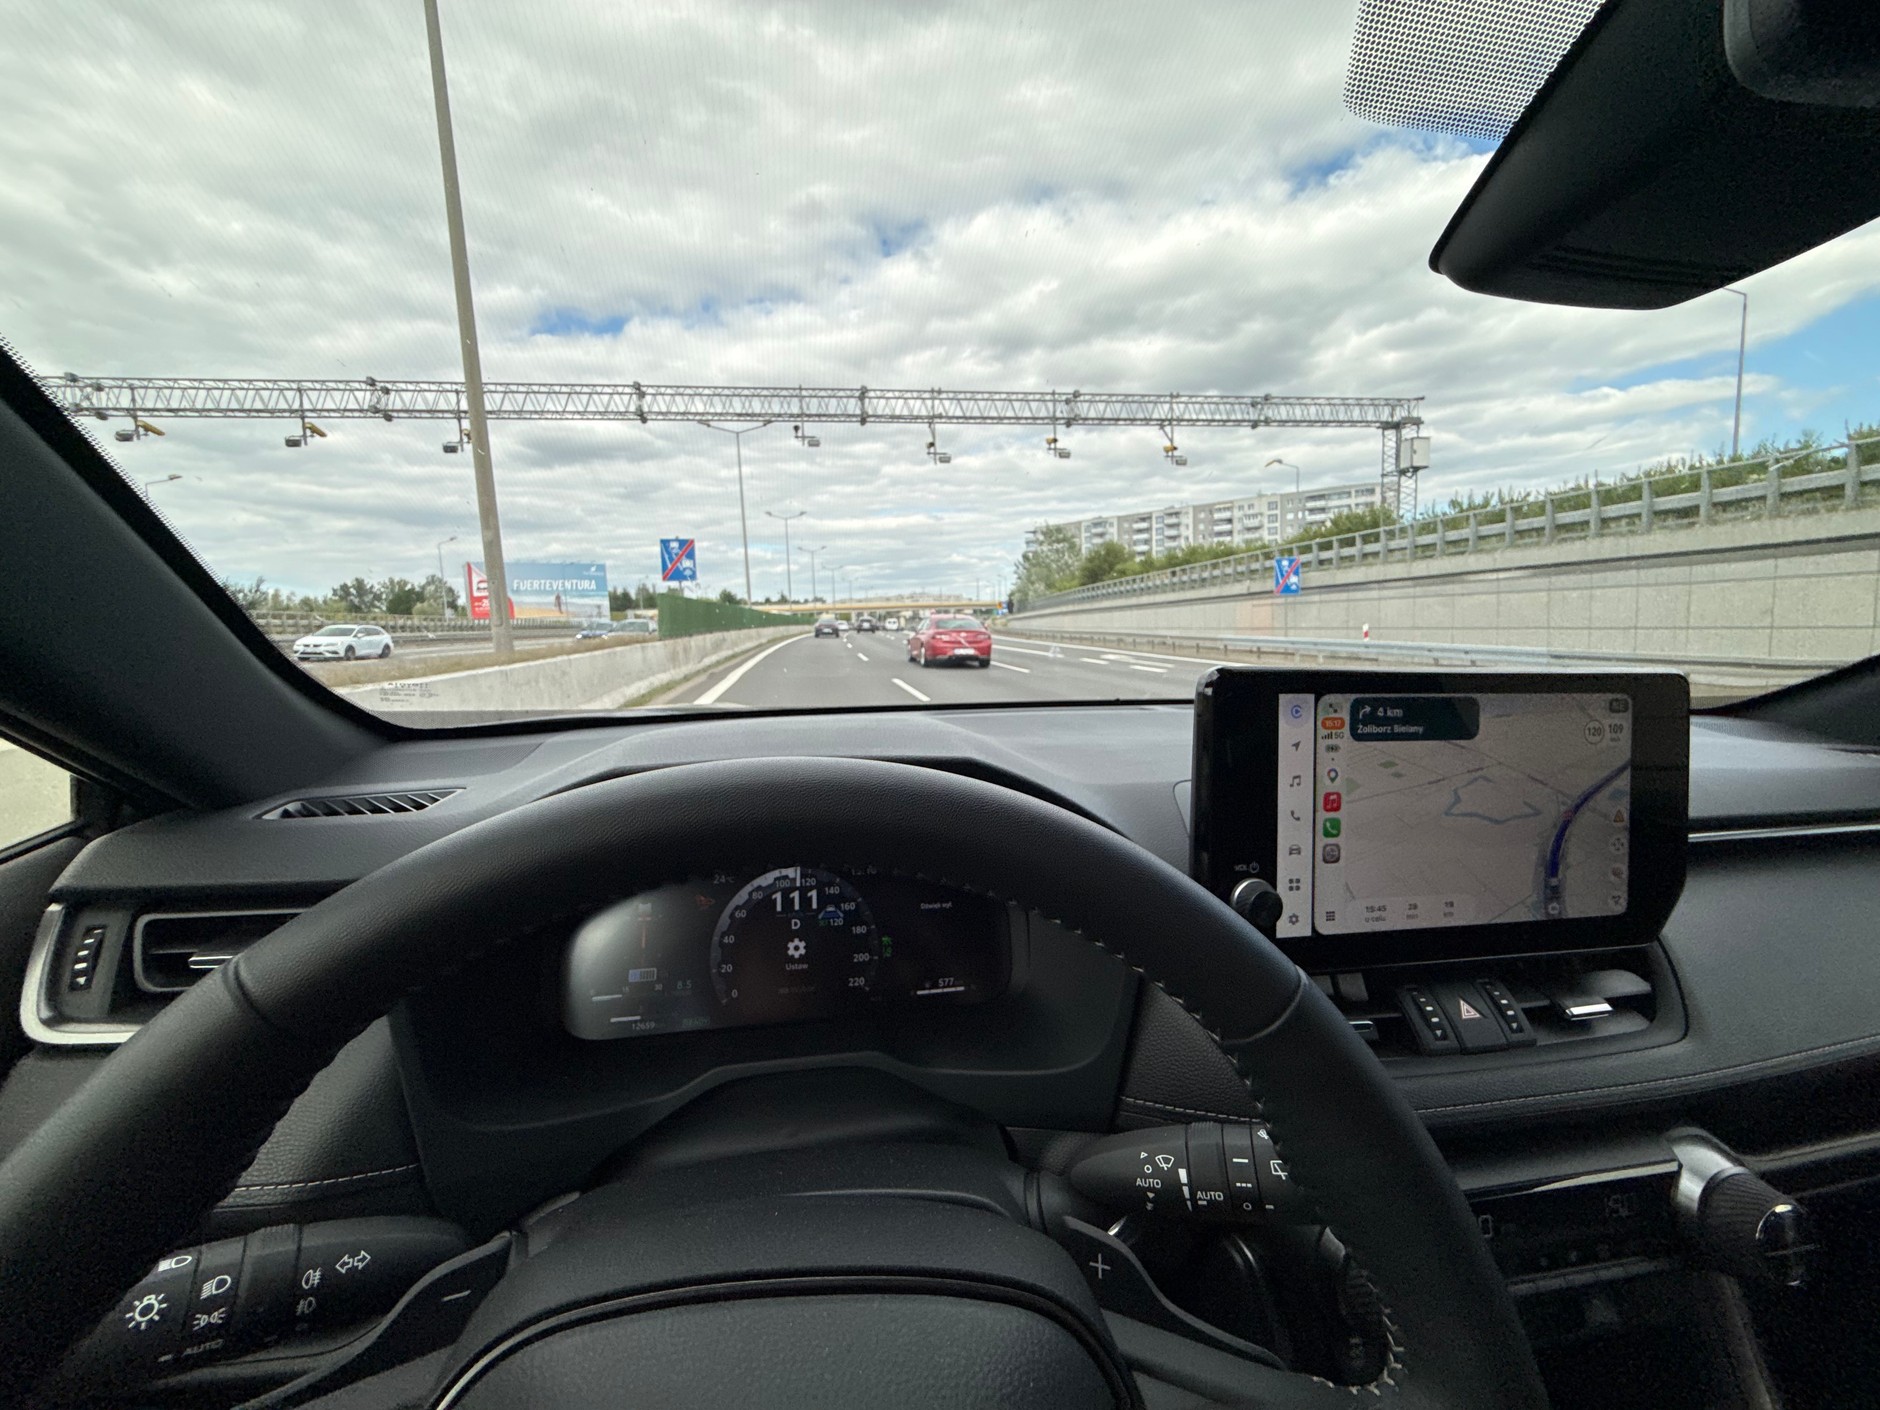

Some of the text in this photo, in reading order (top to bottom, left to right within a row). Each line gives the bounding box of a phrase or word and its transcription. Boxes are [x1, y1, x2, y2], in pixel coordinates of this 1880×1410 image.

[513, 579, 597, 591] FUERTEVENTURA
[1377, 707, 1404, 717] 4 km
[1357, 724, 1424, 735] Żoliborz Bielany
[1587, 726, 1602, 737] 120
[1608, 723, 1624, 735] 109
[1334, 731, 1345, 740] 5G
[775, 880, 791, 888] 100
[801, 878, 817, 887] 120
[752, 891, 763, 900] 80
[824, 886, 840, 895] 140
[772, 889, 818, 912] 111
[840, 902, 856, 911] 160
[735, 909, 747, 919] 60
[791, 918, 801, 930] D
[829, 918, 844, 926] 120
[851, 925, 867, 934] 180
[722, 935, 735, 944] 40
[853, 953, 870, 962] 200
[720, 963, 732, 973] 20
[785, 961, 809, 971] Ustaw
[848, 977, 865, 987] 220
[938, 977, 954, 987] 577
[731, 989, 738, 999] 0
[1135, 1177, 1162, 1189] AUTO
[1196, 1190, 1224, 1201] AUTO
